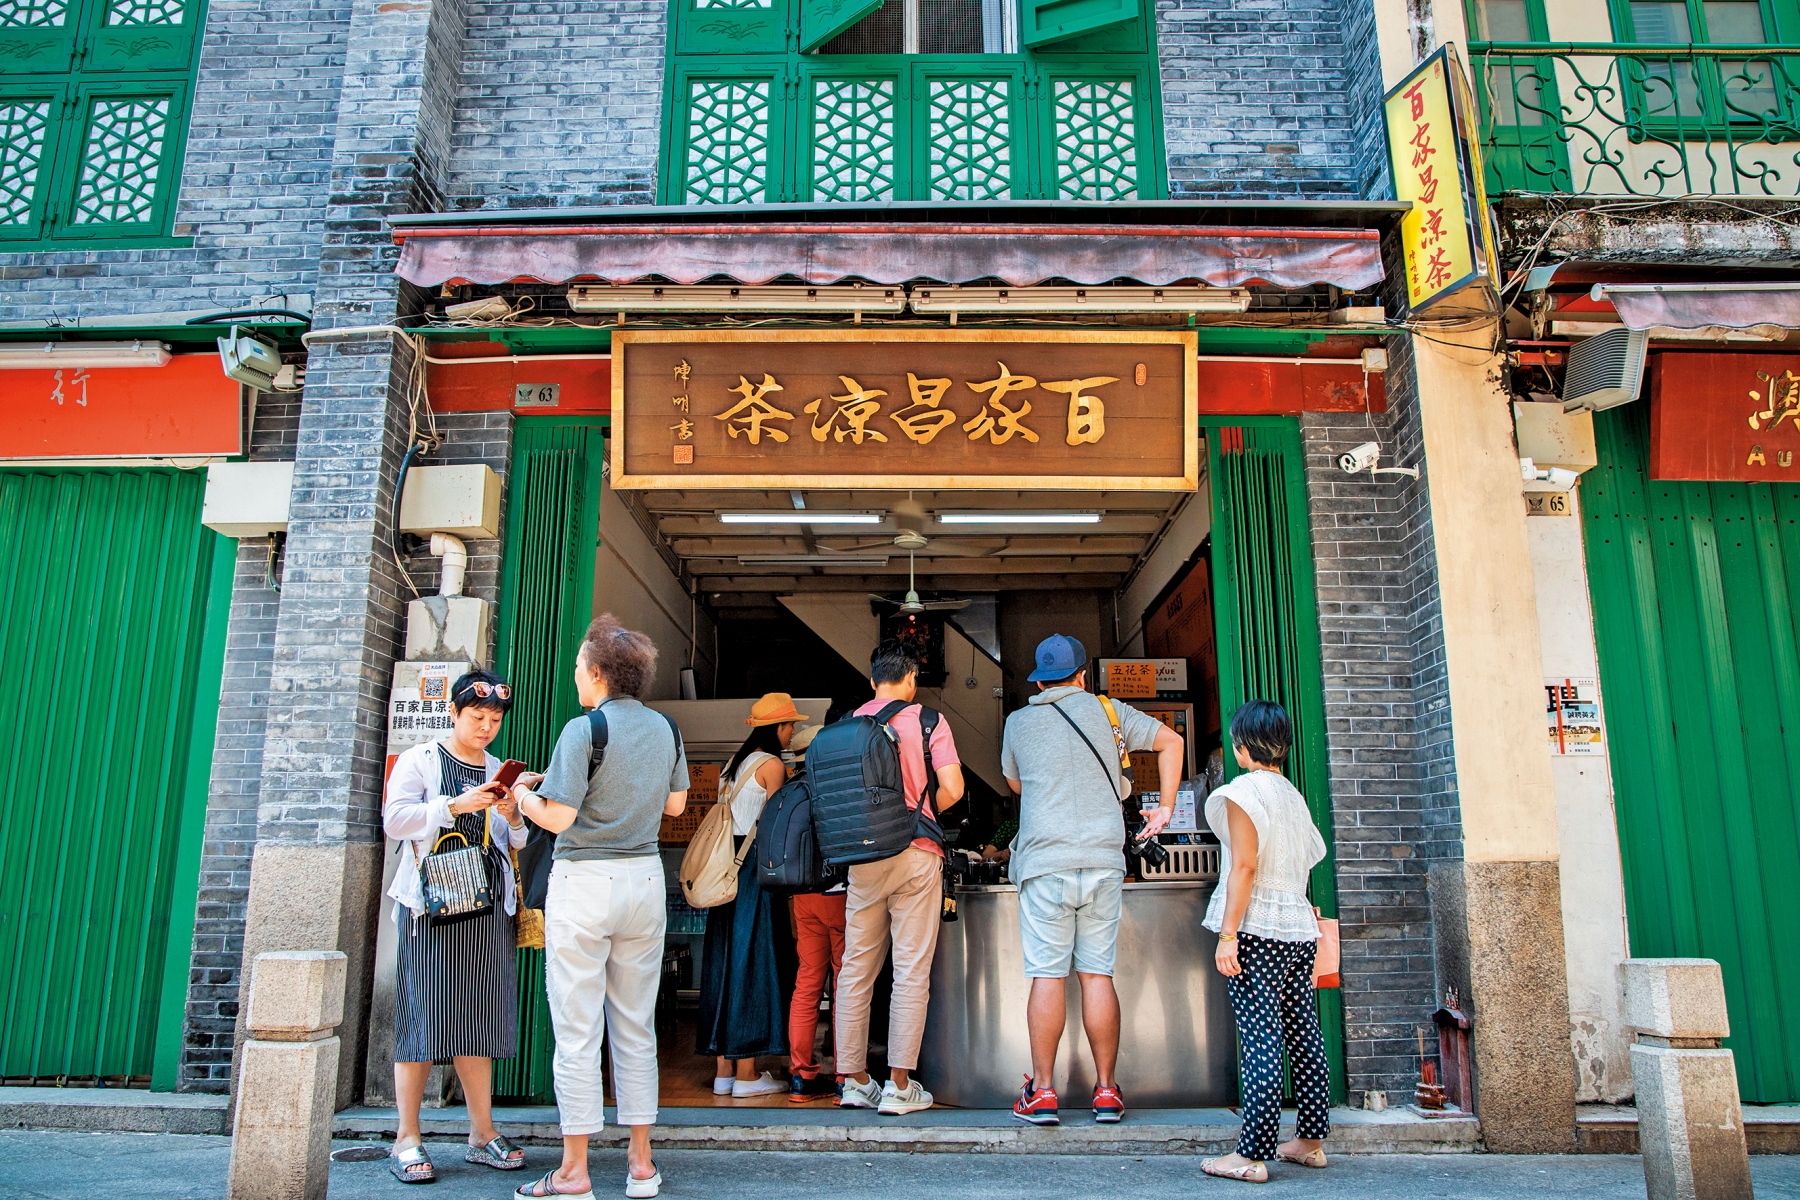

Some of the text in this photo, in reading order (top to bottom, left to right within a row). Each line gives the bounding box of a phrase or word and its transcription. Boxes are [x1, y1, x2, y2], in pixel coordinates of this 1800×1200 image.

[50, 367, 91, 407] 行
[538, 387, 553, 402] 63
[1550, 495, 1565, 512] 65
[1111, 664, 1151, 676] 五花茶
[394, 700, 451, 713] 百家昌凉
[692, 766, 704, 777] 茶
